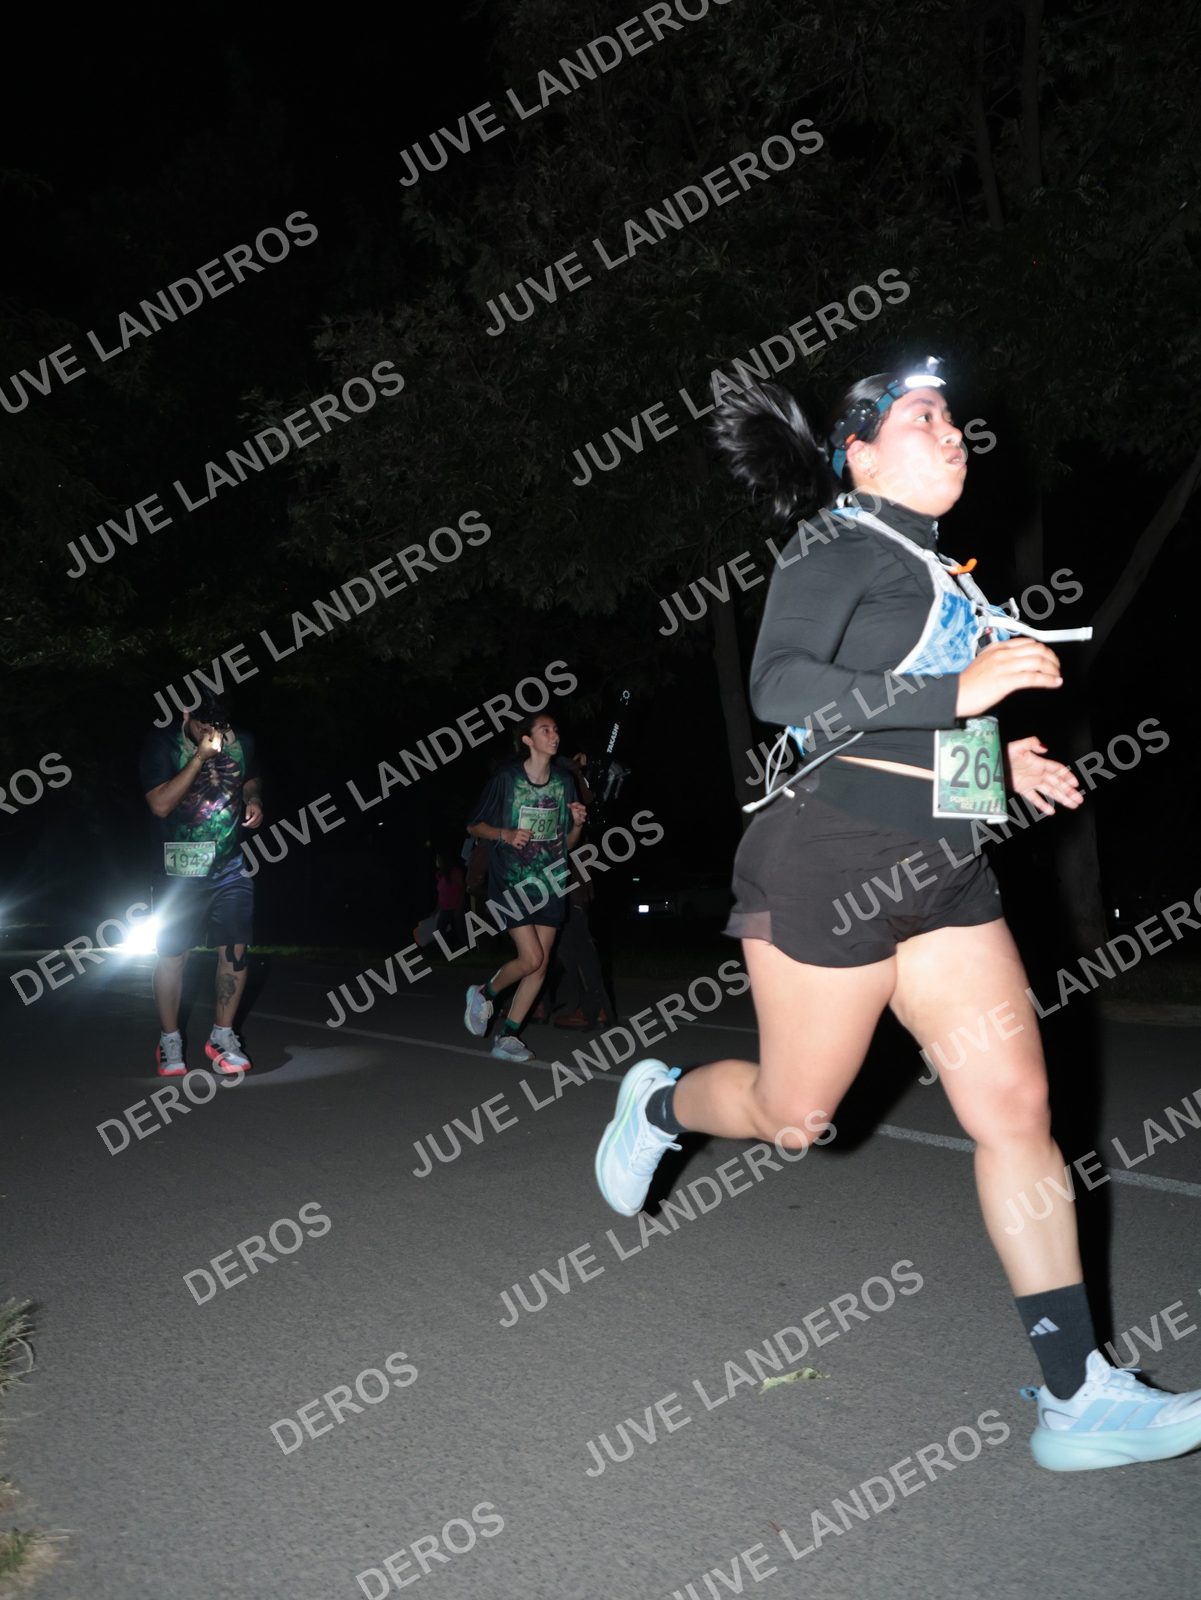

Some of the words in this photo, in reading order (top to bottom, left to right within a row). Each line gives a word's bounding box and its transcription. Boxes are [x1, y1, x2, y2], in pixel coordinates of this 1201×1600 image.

[606, 723, 619, 753] TAKASHI
[528, 818, 554, 833] 787
[169, 853, 211, 869] 1942
